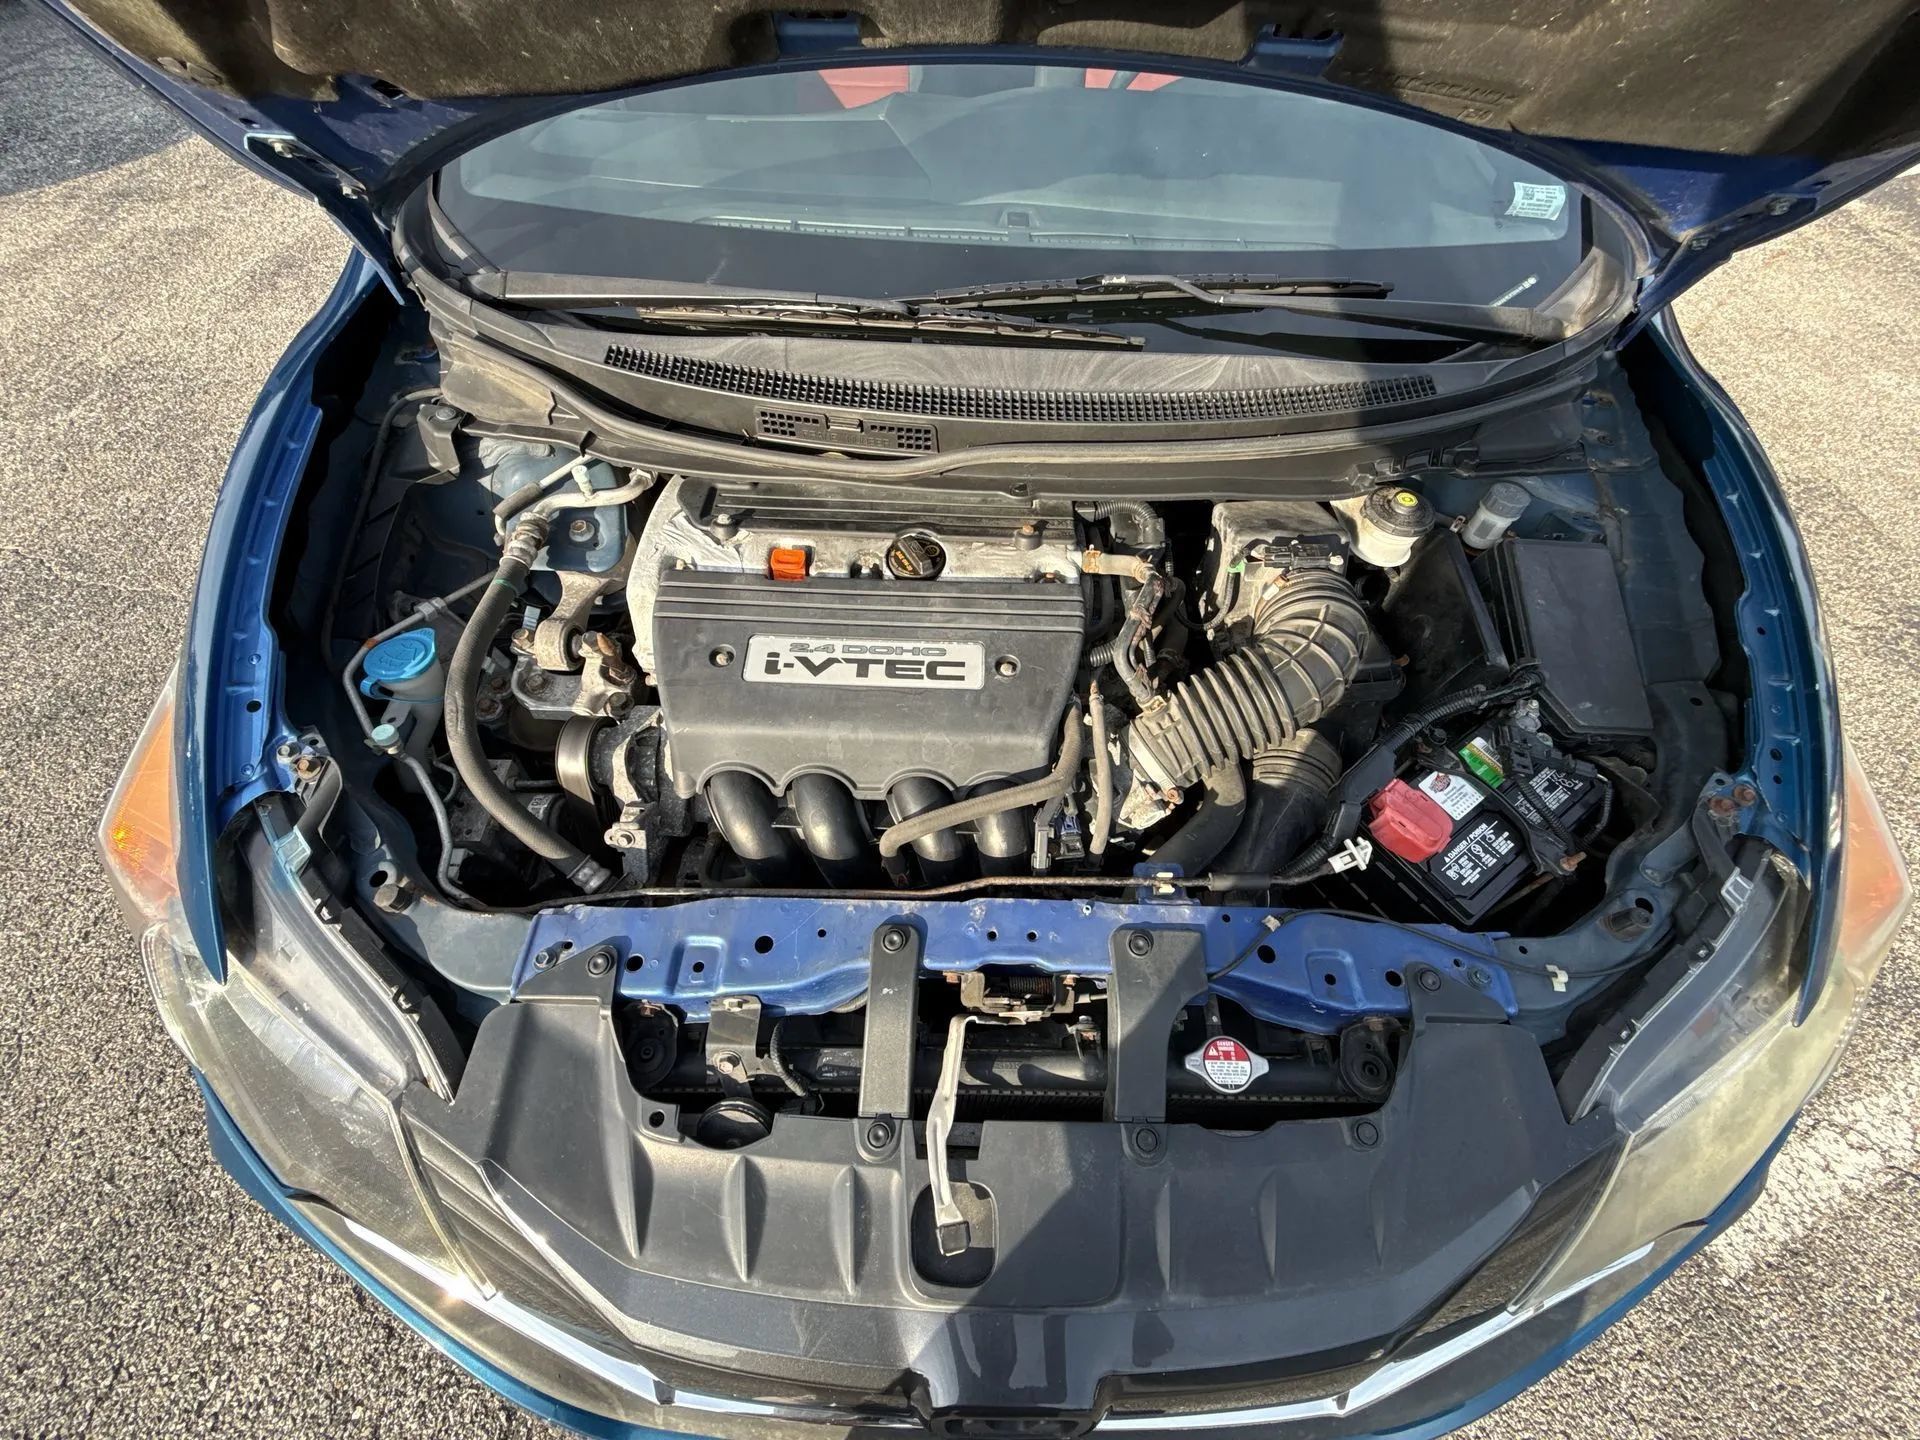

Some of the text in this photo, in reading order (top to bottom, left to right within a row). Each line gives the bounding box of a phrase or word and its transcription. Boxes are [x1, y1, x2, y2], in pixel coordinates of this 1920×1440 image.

[789, 642, 947, 657] 2.4 DOHC
[764, 651, 966, 682] i-VTEC
[1447, 839, 1469, 859] DANGER
[1469, 822, 1489, 840] POISON
